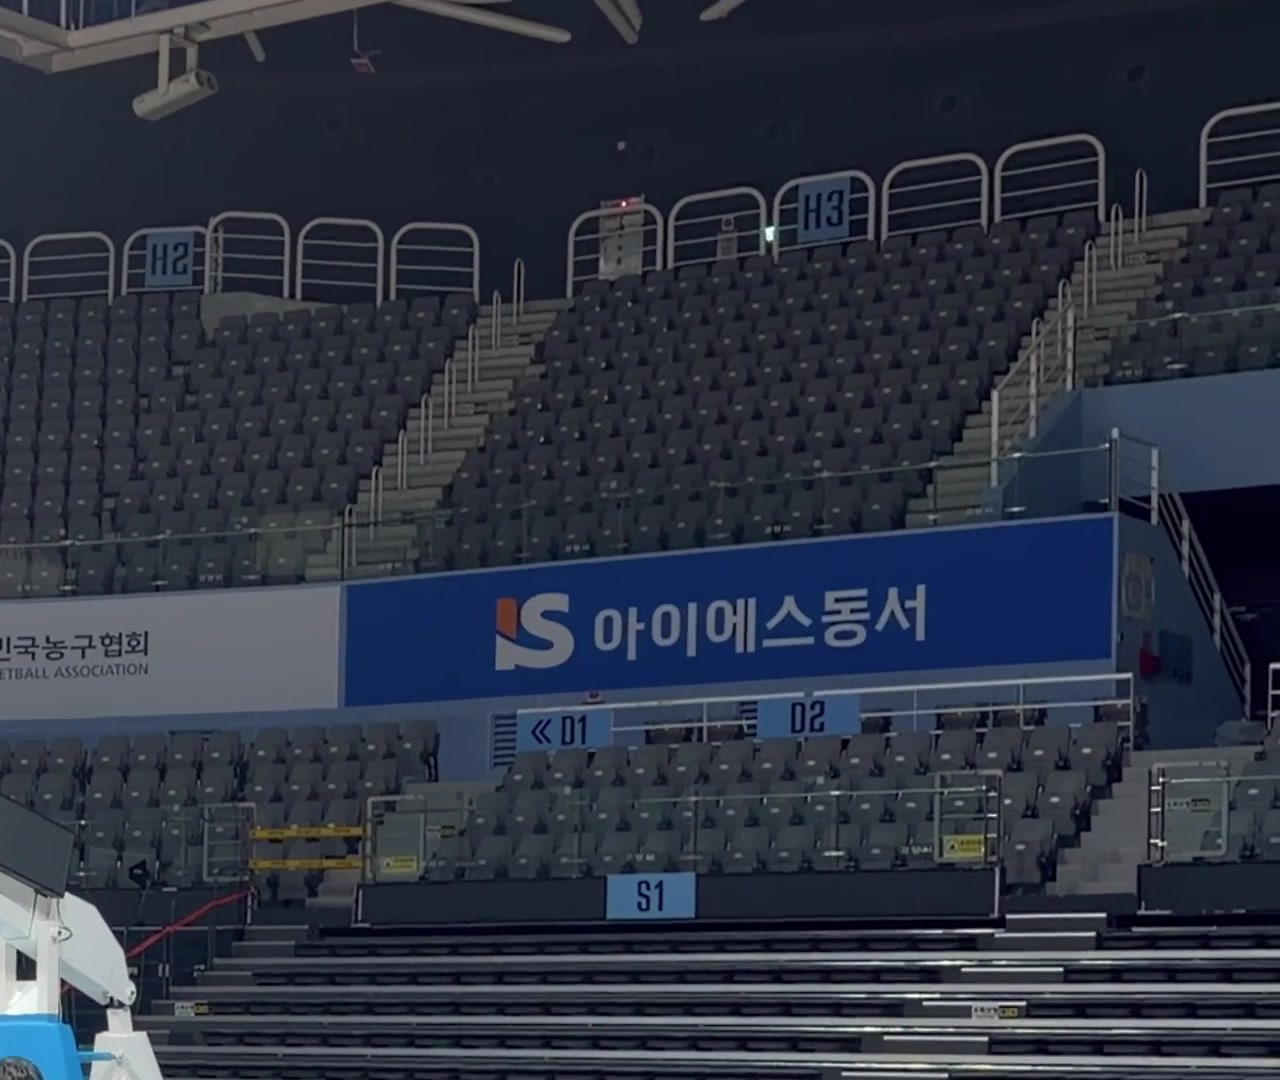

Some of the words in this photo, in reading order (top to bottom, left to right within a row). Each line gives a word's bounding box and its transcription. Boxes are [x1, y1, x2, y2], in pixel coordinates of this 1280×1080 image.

[804, 190, 844, 231] H3
[151, 242, 188, 276] H2
[594, 584, 926, 661] 아이에스동서
[53, 663, 149, 679] ASSOCIATION
[561, 714, 588, 746] D1
[790, 701, 825, 734] D2
[636, 880, 665, 913] S1
